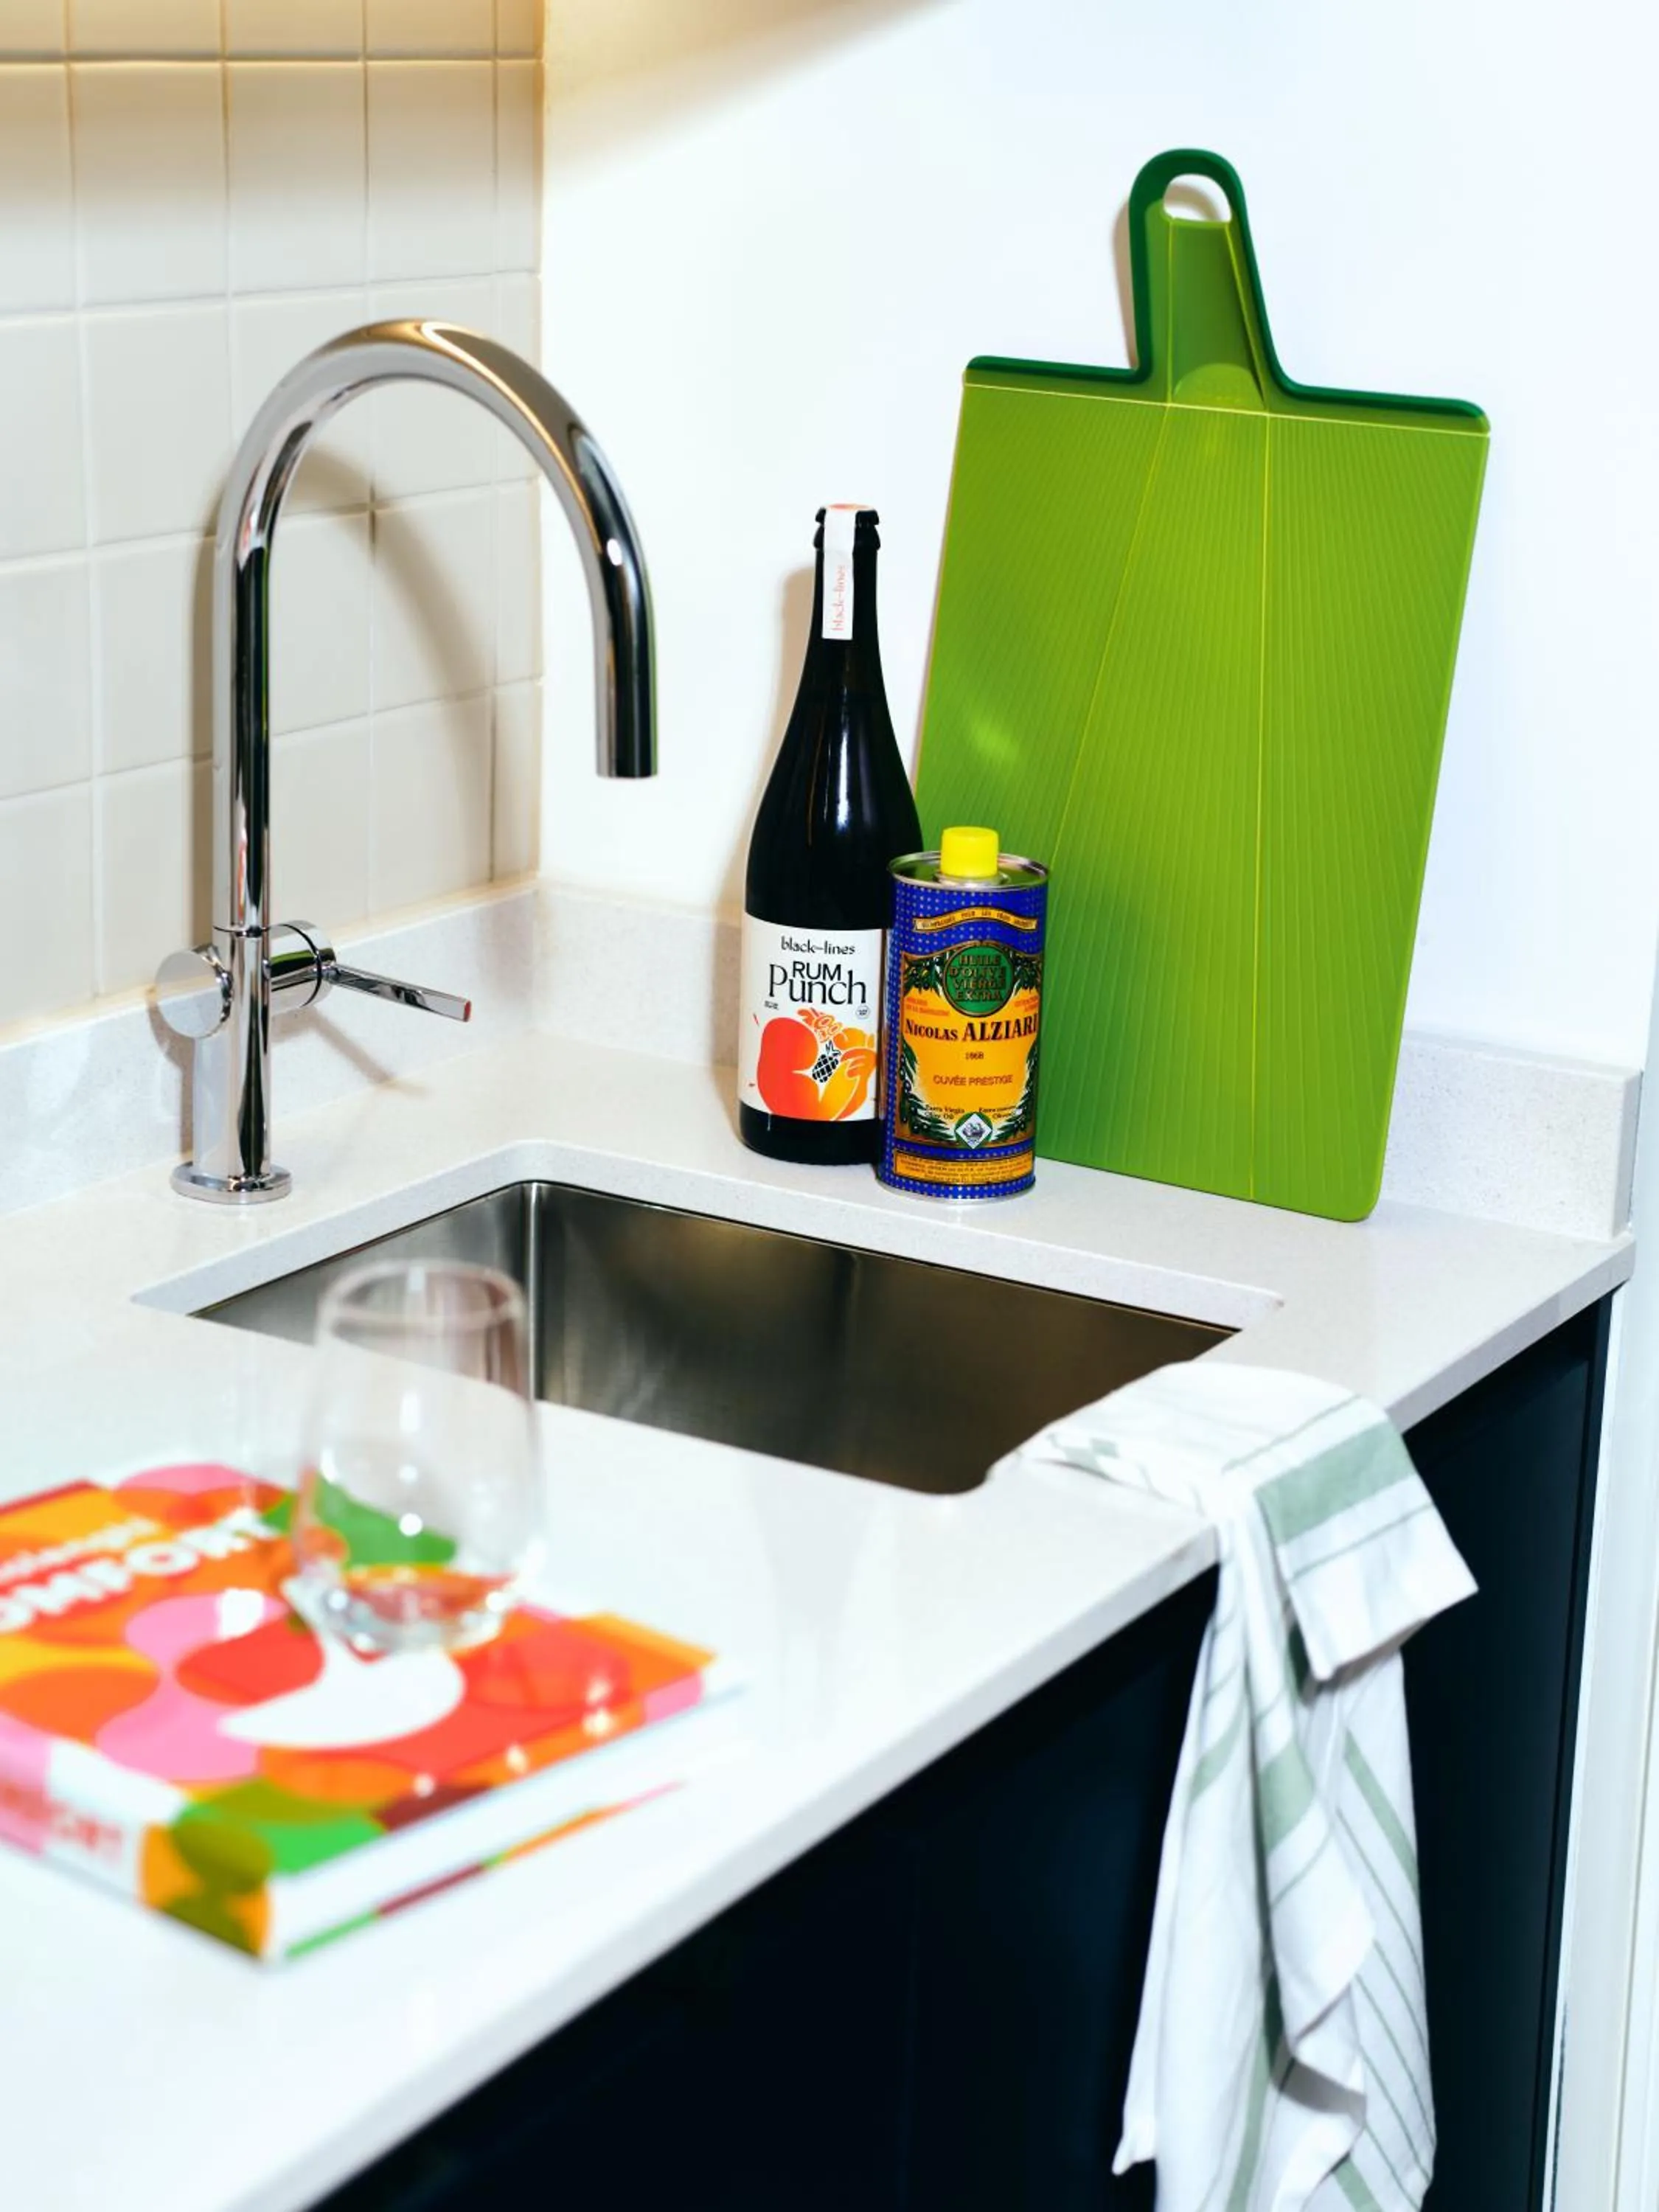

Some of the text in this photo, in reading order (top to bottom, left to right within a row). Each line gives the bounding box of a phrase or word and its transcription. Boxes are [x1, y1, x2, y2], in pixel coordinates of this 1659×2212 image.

[781, 936, 855, 955] black-lines
[793, 961, 841, 981] RUM
[769, 964, 866, 1005] Punch
[933, 1074, 1014, 1086] CUVÉE PRESTIGE
